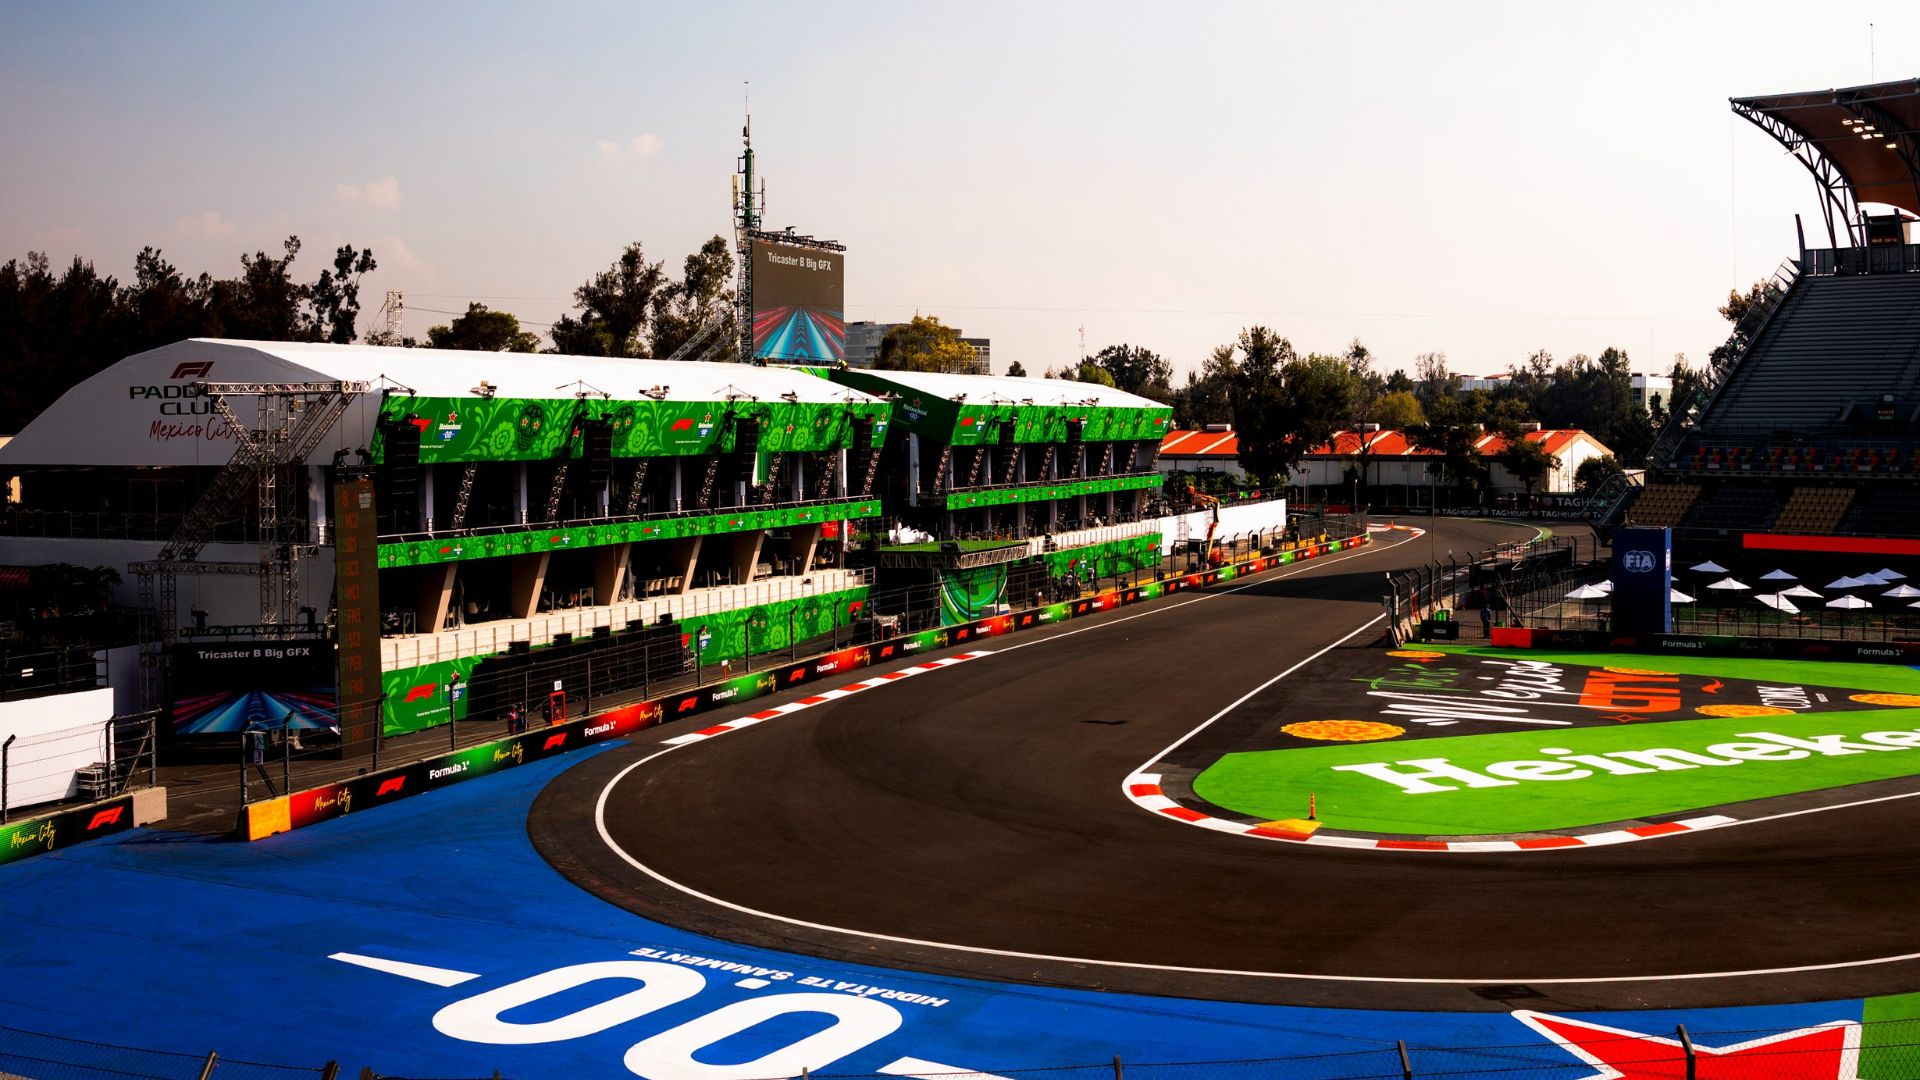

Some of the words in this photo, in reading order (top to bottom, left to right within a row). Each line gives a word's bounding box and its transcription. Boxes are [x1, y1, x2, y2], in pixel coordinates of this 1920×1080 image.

[768, 252, 798, 266] Tricaster
[800, 257, 804, 266] B
[806, 258, 817, 271] Big
[818, 259, 831, 271] GFX
[150, 419, 203, 443] Mexico
[198, 650, 250, 660] Tricaster
[253, 649, 261, 658] B
[264, 648, 283, 658] Big
[286, 648, 310, 656] GFX
[1662, 640, 1696, 648] Formula
[1857, 648, 1894, 656] Formula
[712, 689, 733, 702] Formula
[1578, 670, 1681, 713] CITY
[1756, 686, 1812, 709] CDMX
[584, 722, 610, 737] Formula
[430, 763, 461, 780] Formula
[1331, 728, 1920, 794] Heineke
[314, 796, 334, 810] Mexico
[337, 787, 352, 812] City
[10, 831, 36, 849] Mexico
[38, 820, 56, 850] City
[628, 947, 794, 981] SANAMENTE
